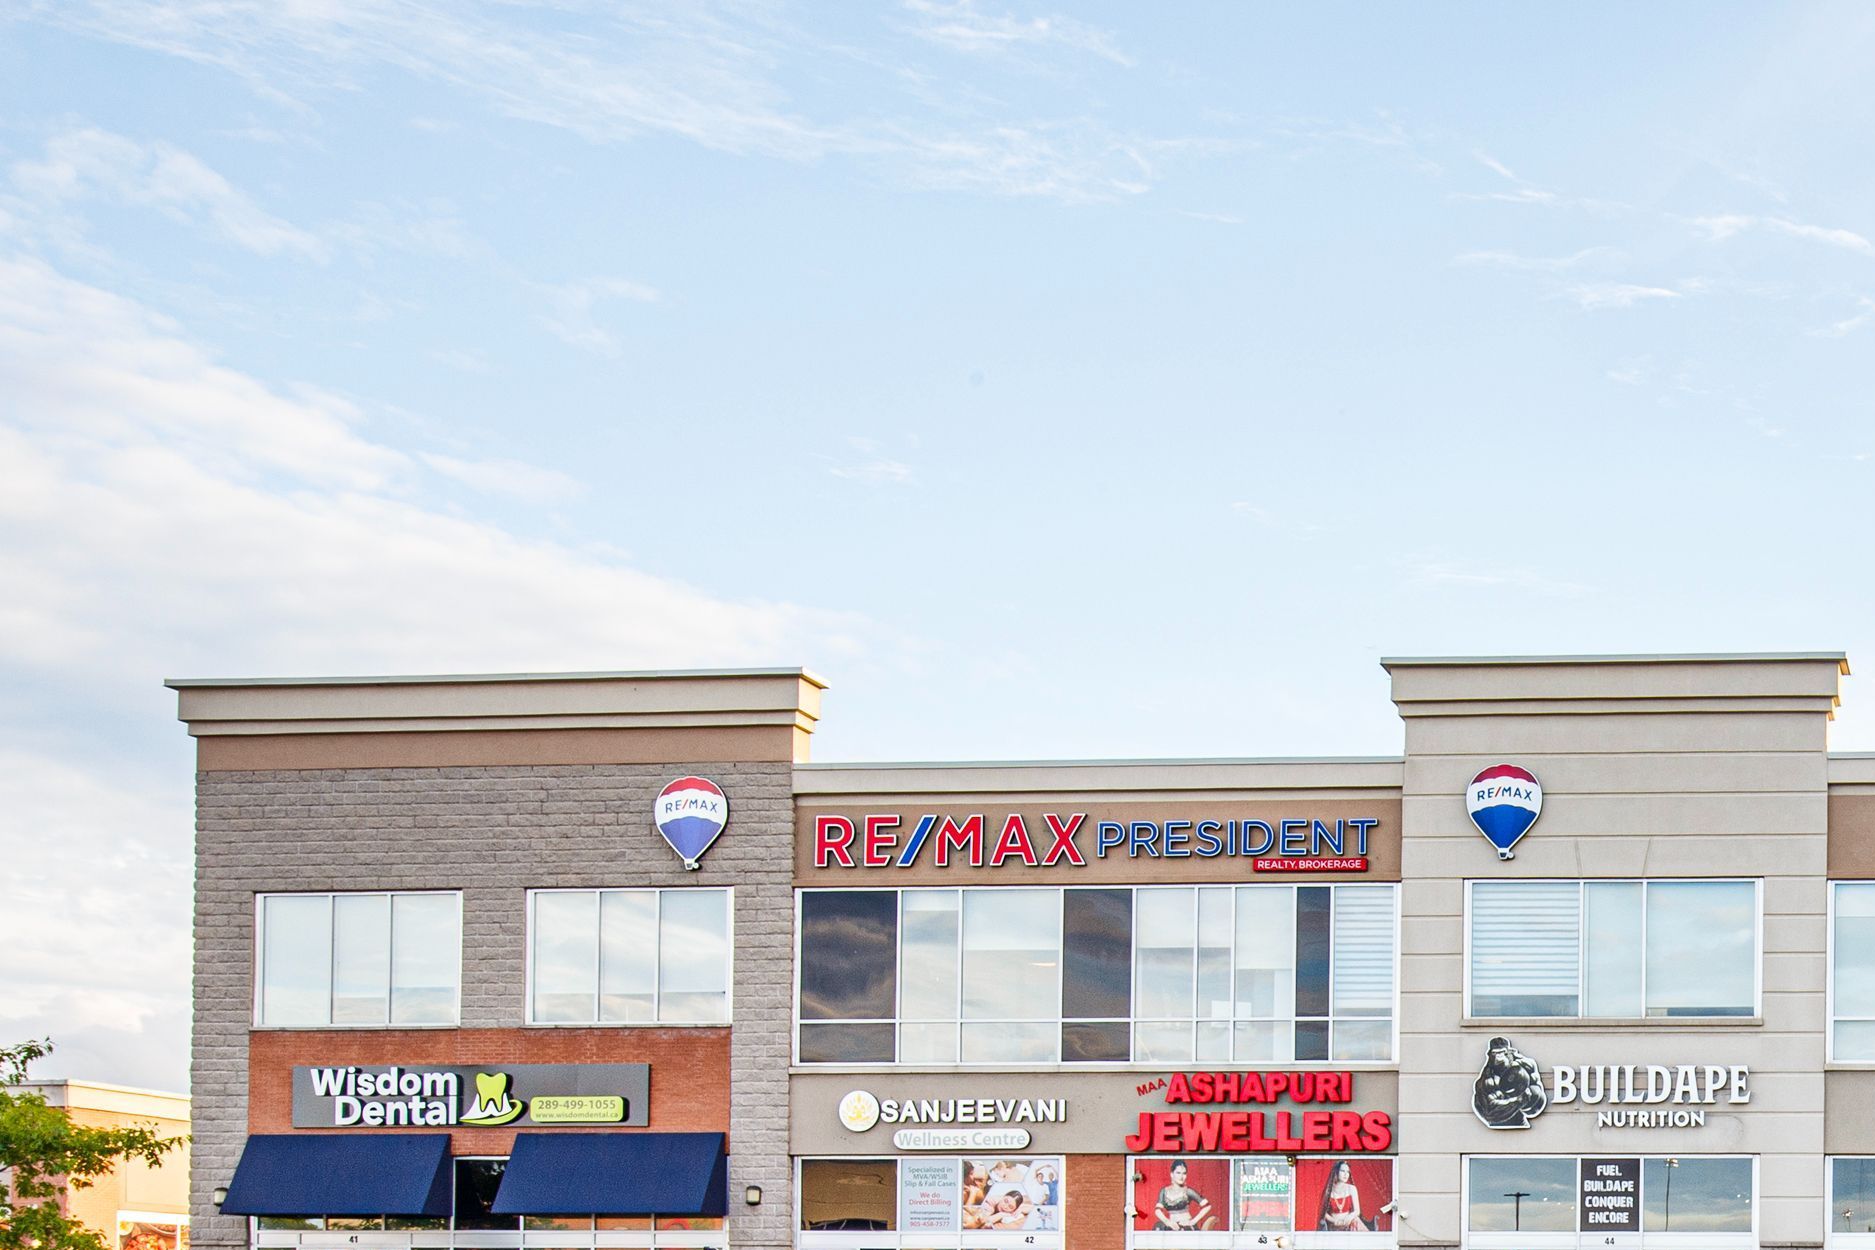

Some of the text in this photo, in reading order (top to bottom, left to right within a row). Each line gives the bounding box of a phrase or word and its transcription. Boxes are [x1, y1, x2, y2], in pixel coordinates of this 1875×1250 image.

[1477, 787, 1532, 801] RE/MAX
[665, 799, 718, 813] RE/MAX
[813, 813, 1379, 867] RE/MAX PRESIDENT
[1298, 859, 1362, 869] BROKERAGE
[310, 1067, 459, 1096] Wisdom
[1136, 1071, 1354, 1105] MAA ASHAPURI
[1550, 1065, 1751, 1105] BUILDAPE
[334, 1095, 459, 1126] Dental
[538, 1100, 616, 1110] 289-499-1055
[880, 1099, 1068, 1123] SANJEEVANI
[1597, 1110, 1706, 1128] NUTRITION
[900, 1131, 1026, 1147] Wellness Centre
[1125, 1111, 1392, 1153] JEWELLERS
[1596, 1165, 1622, 1176] FUEL
[1583, 1180, 1635, 1192] BUILDAPE
[1585, 1196, 1634, 1210] CONQUER
[1588, 1212, 1630, 1224] ENCORE
[349, 1235, 359, 1243] 41
[1024, 1236, 1035, 1244] 42
[1258, 1236, 1268, 1244] 43
[1604, 1237, 1615, 1245] 44
